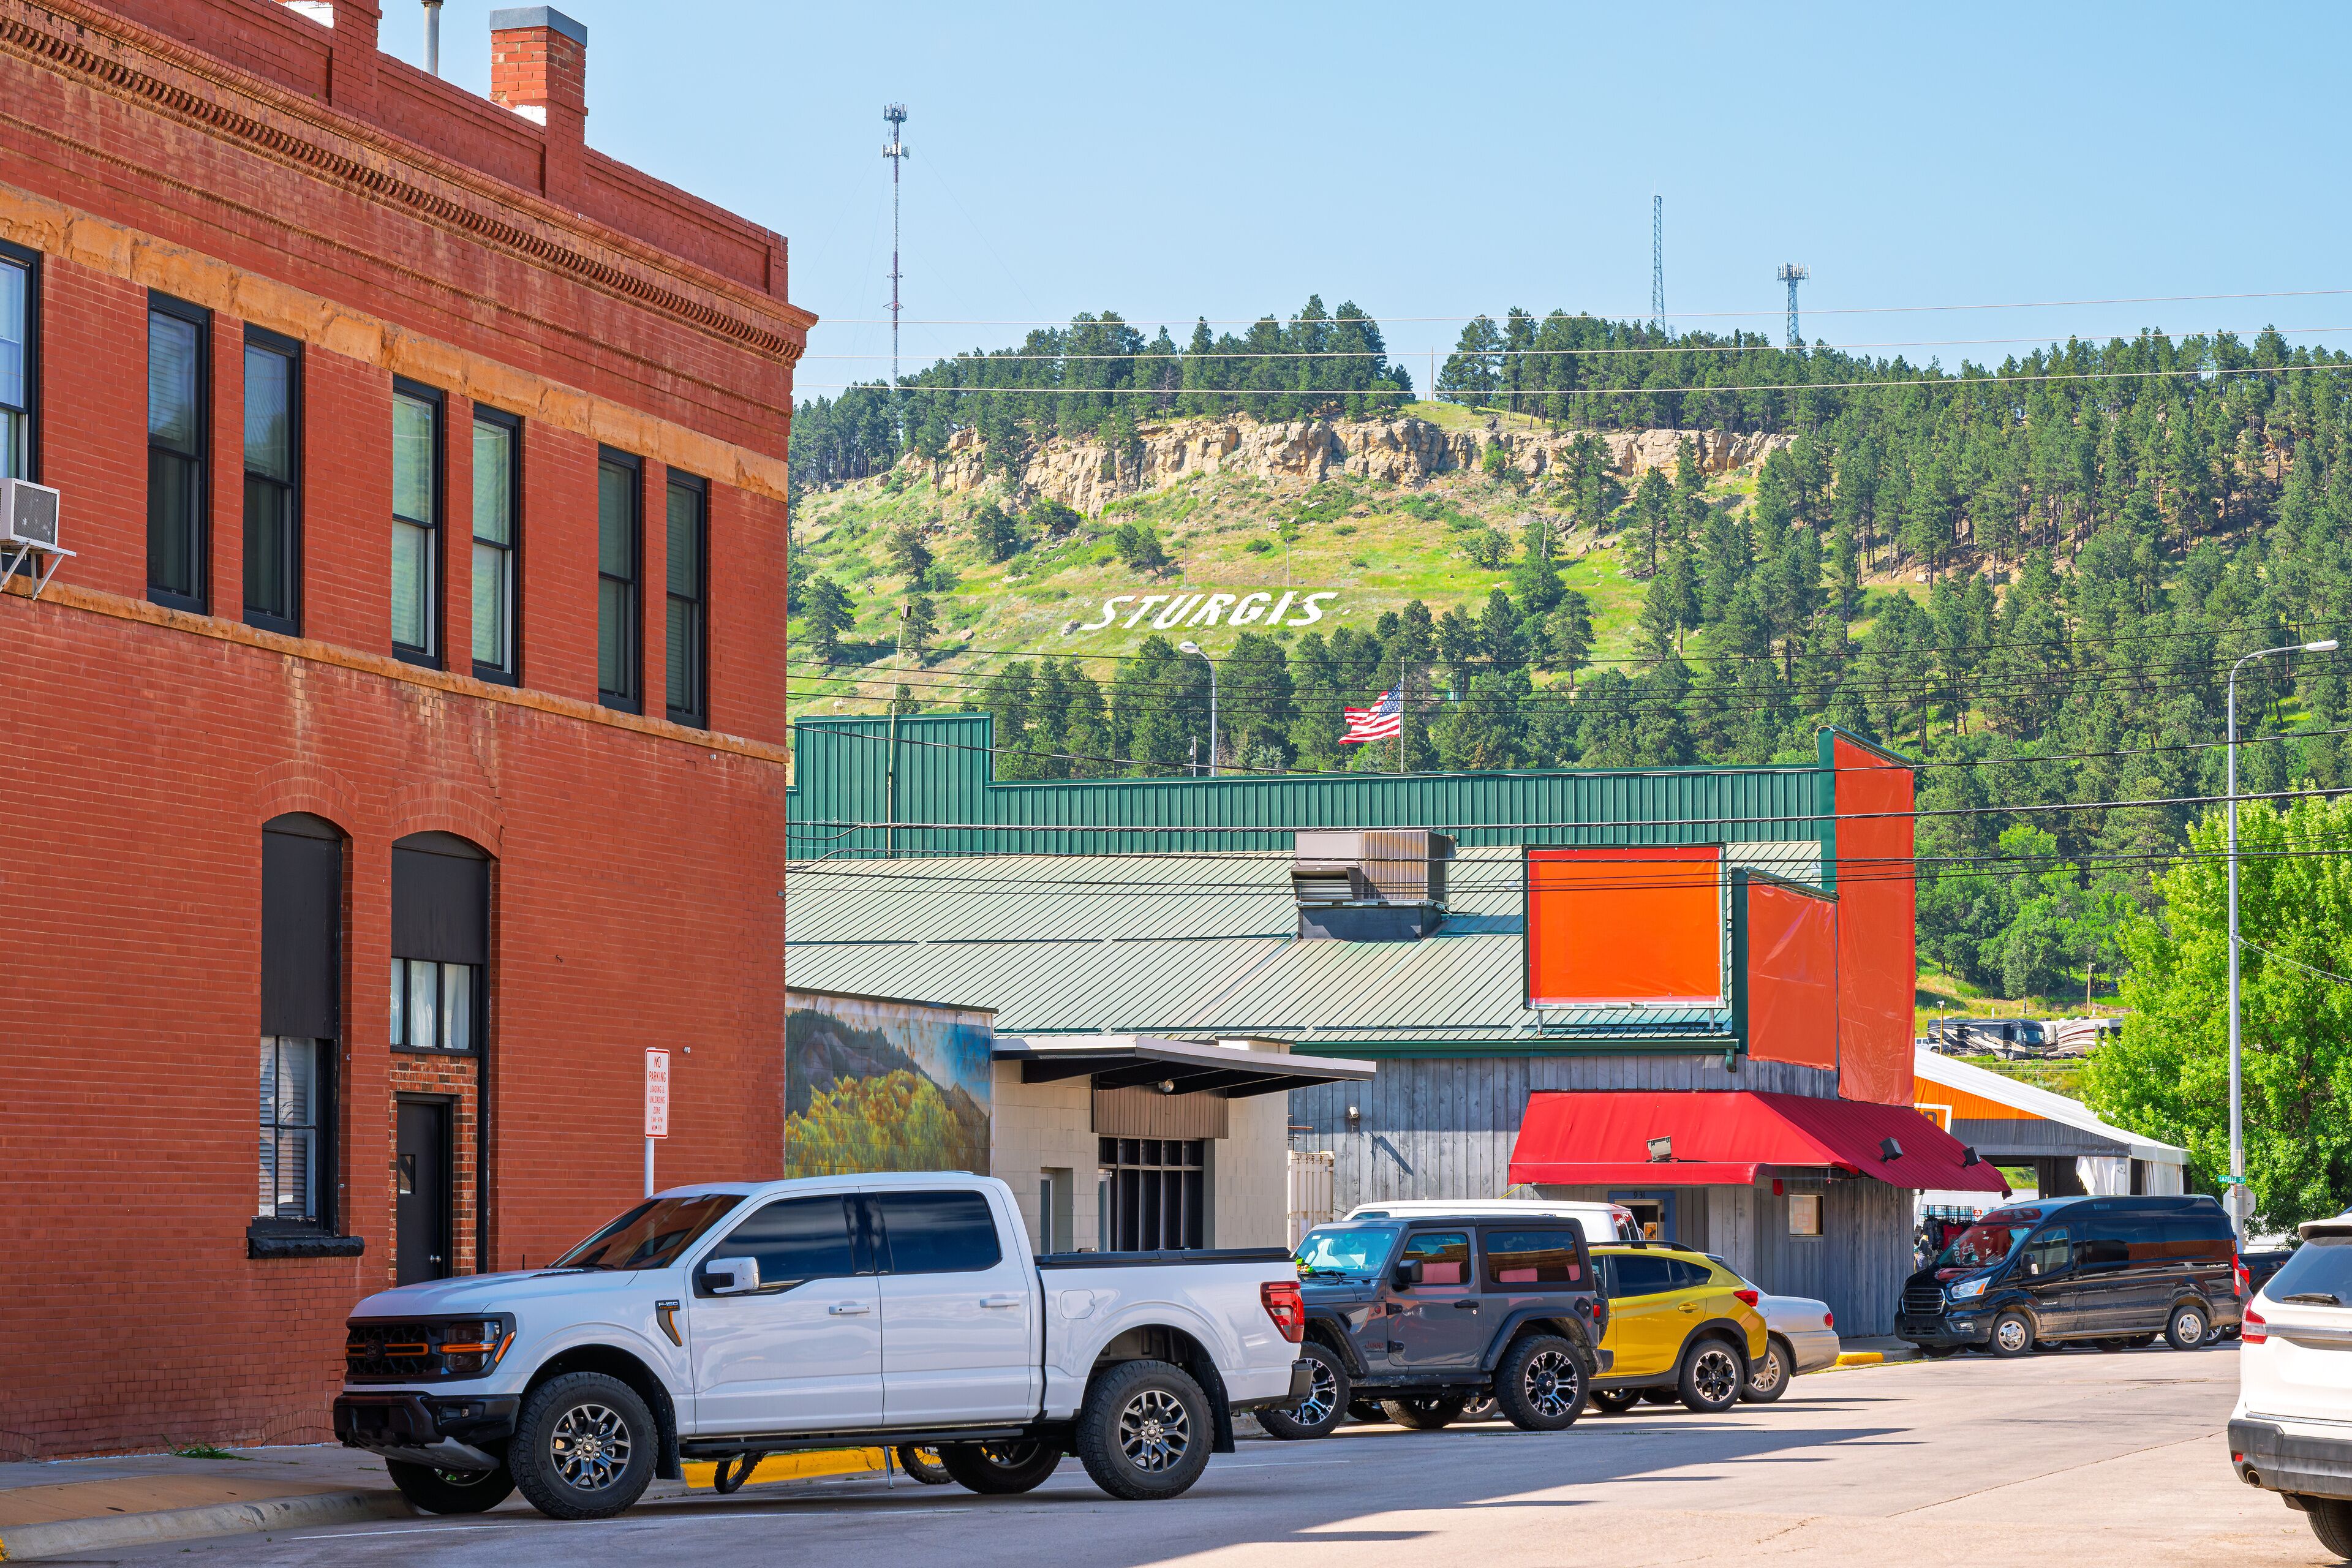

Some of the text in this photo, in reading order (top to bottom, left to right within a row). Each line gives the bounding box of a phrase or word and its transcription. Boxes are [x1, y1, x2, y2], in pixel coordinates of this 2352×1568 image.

[1080, 591, 1339, 630] STURGIS
[654, 1056, 662, 1068] NO
[649, 1071, 666, 1083] PARKING
[1633, 1191, 1645, 1199] 931
